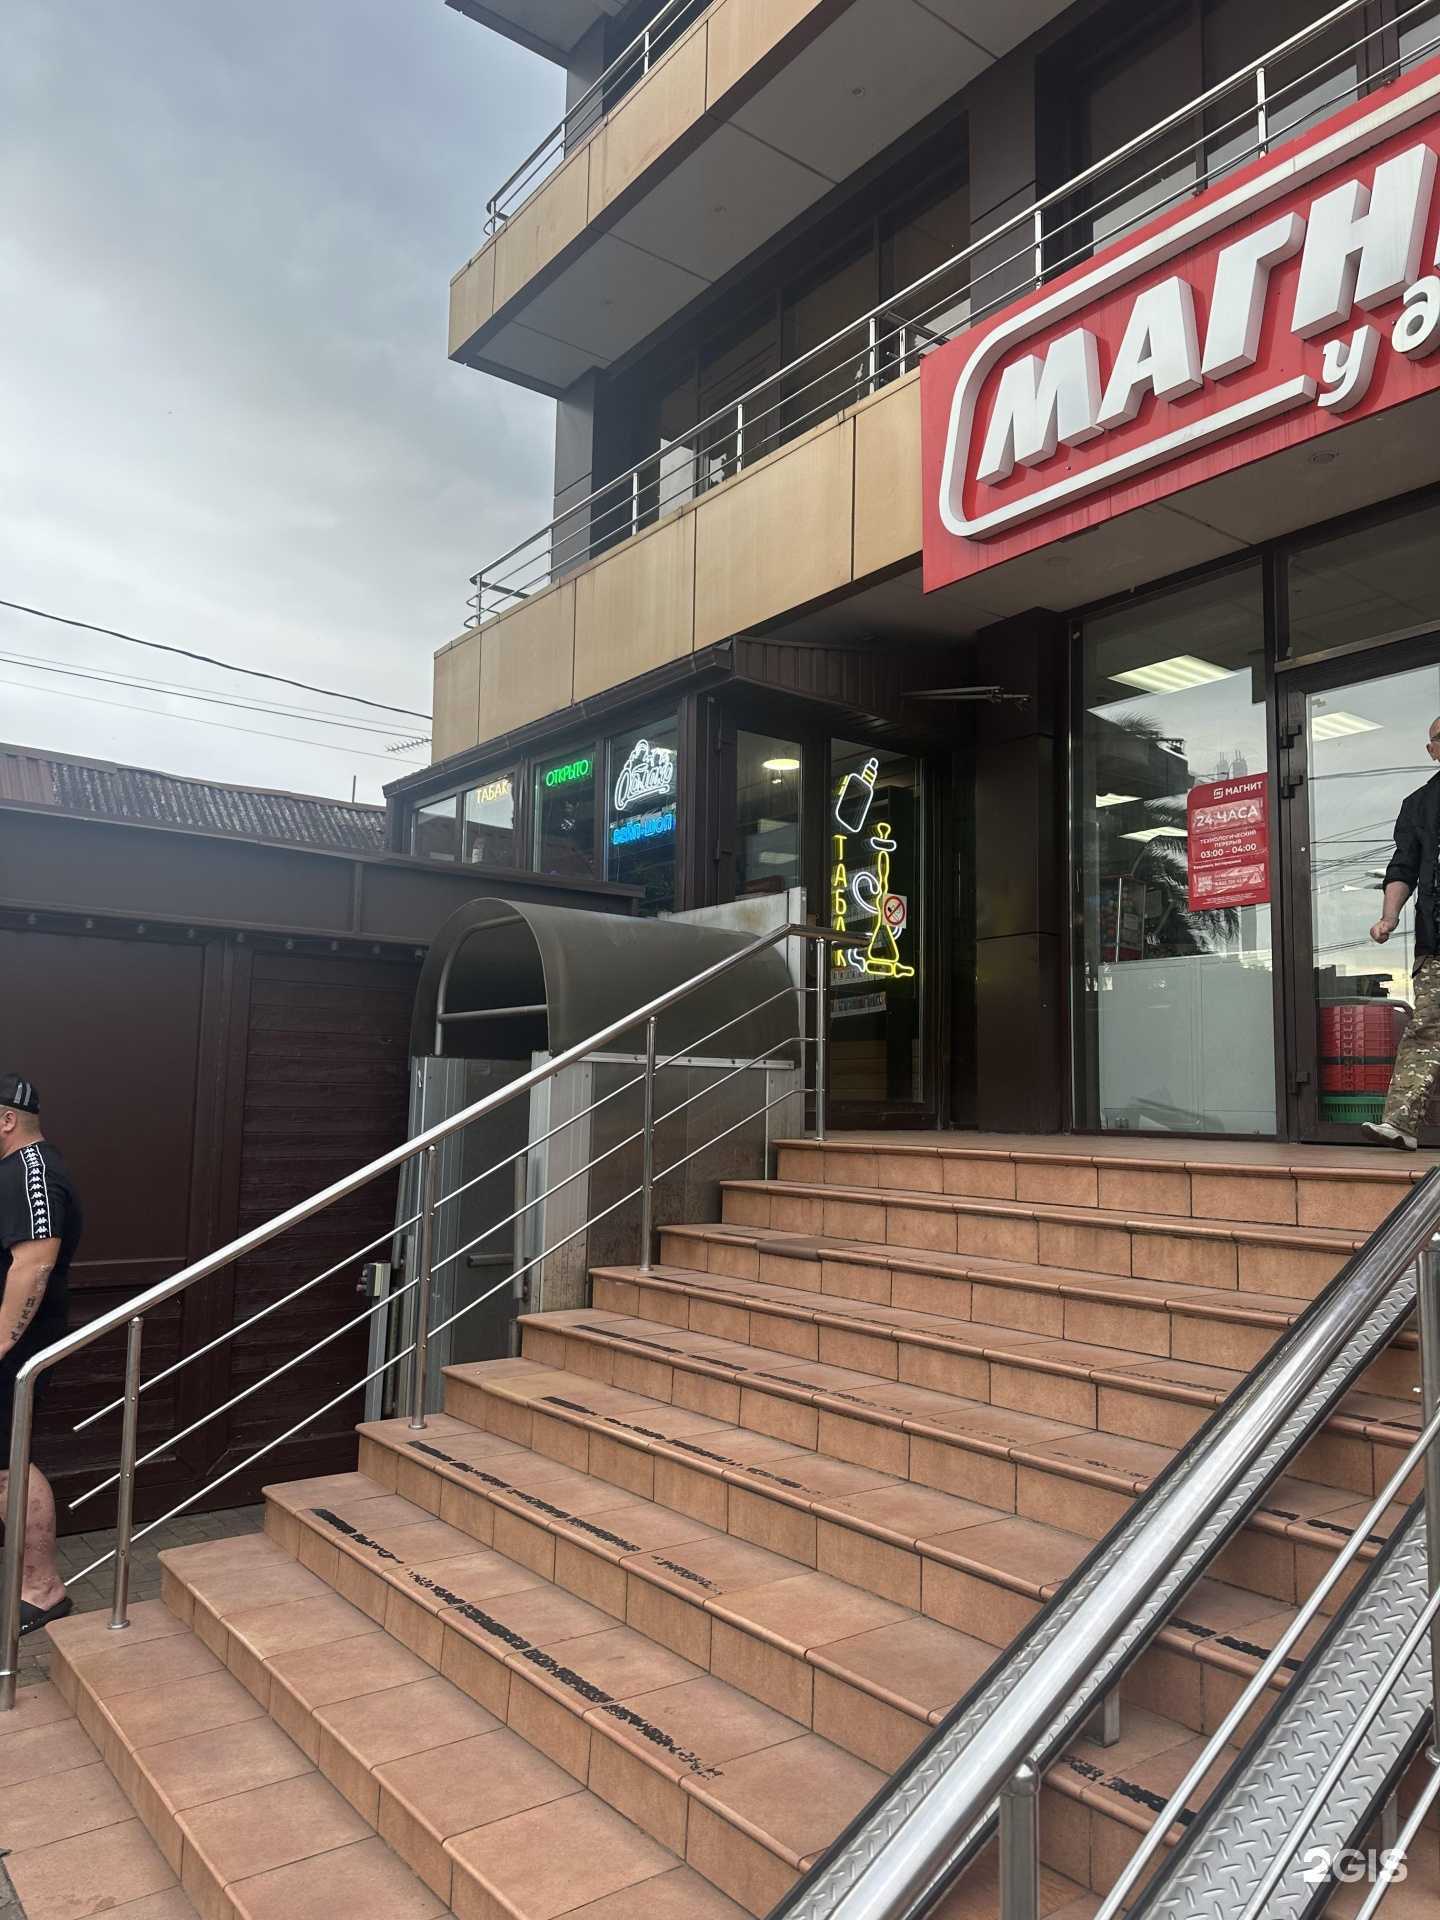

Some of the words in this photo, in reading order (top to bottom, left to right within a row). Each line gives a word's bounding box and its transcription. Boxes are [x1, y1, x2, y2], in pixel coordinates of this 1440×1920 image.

[975, 142, 1440, 486] МАГН
[545, 759, 589, 787] ОТКРЫТО
[476, 780, 508, 804] ТАБАК
[1225, 781, 1263, 796] МАГНИТ
[1196, 815, 1213, 827] 24
[1216, 805, 1259, 823] ЧАСА
[1200, 829, 1257, 845] ТЕХНОЛОГИЧЕСКИЙ
[1200, 848, 1224, 859] 03:00
[1231, 843, 1257, 854] 04:00
